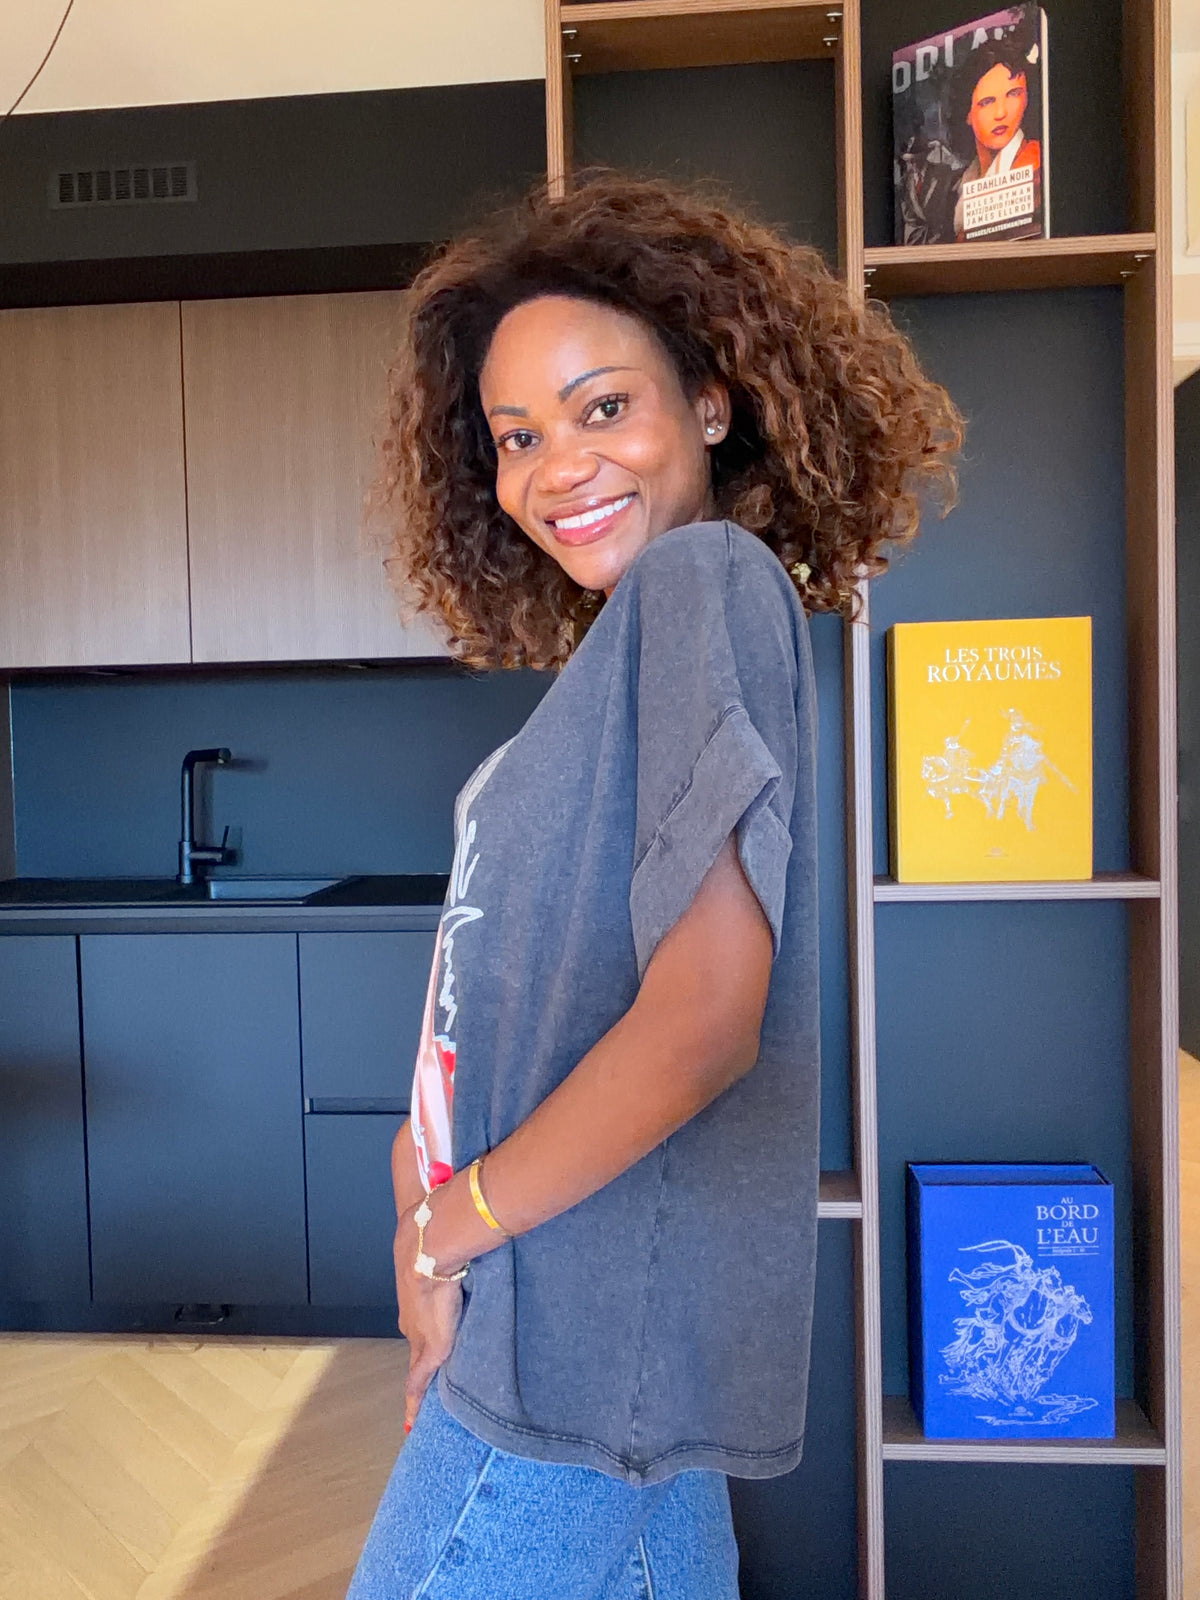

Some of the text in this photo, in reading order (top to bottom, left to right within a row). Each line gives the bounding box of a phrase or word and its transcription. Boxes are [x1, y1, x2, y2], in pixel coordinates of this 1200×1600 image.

[966, 168, 1030, 195] LE DAHLIA NOIR
[966, 196, 994, 209] MILES
[966, 202, 1031, 226] JAMES ELLROY
[945, 645, 1043, 663] LES TROIS
[927, 661, 1061, 683] ROYAUMES
[1036, 1204, 1099, 1220] BORD
[1061, 1220, 1074, 1228] DE
[1037, 1227, 1098, 1245] L'EAU
